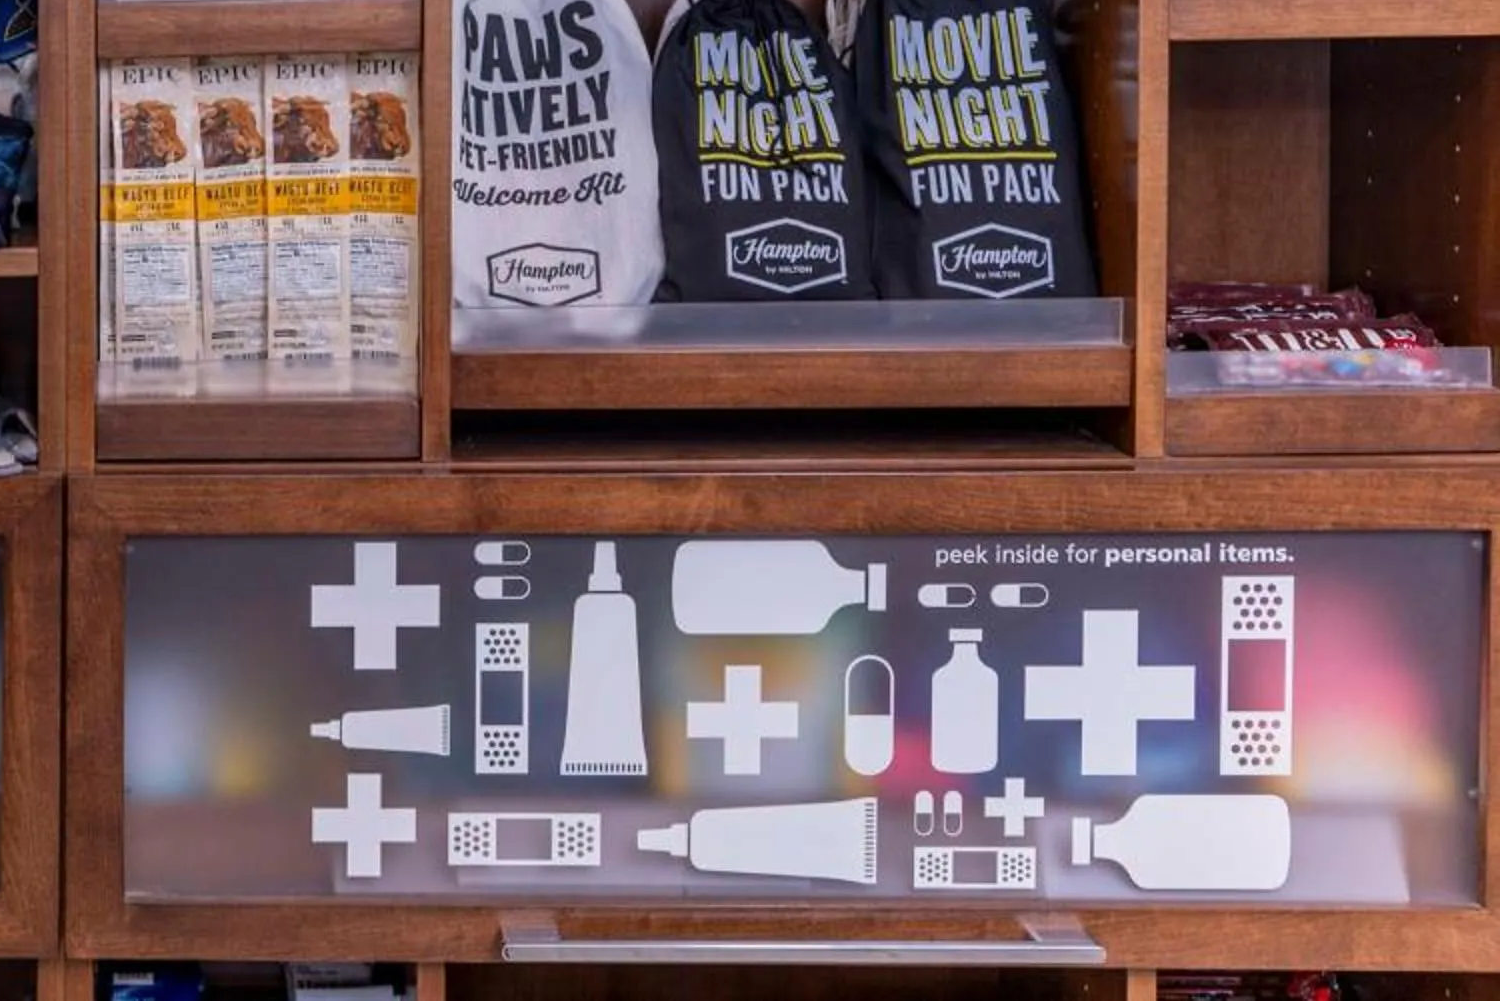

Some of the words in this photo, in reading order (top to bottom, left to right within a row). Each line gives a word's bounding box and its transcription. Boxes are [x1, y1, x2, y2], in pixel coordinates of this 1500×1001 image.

[463, 0, 604, 83] PAWS
[890, 7, 1046, 84] MOVIE
[123, 67, 180, 84] EPIC
[199, 65, 253, 85] EPIC
[276, 64, 334, 80] EPIC
[357, 59, 412, 75] EPIC
[694, 30, 828, 98] MOVIE
[461, 70, 610, 137] ATIVELY
[898, 81, 1051, 151] NIGHT
[699, 89, 840, 156] NIGHT
[453, 178, 570, 206] Welcome
[574, 171, 626, 205] Kit
[701, 164, 761, 203] FUN
[771, 163, 848, 204] PACK
[911, 164, 973, 206] FUN
[983, 164, 1061, 203] PACK
[734, 237, 838, 266] Hampton
[942, 243, 1047, 272] Hampton
[495, 259, 594, 283] Hampton
[935, 544, 988, 567] peek
[995, 544, 1059, 564] inside
[1065, 543, 1098, 563] for
[1104, 542, 1211, 567] personal
[1219, 542, 1295, 563] items.
